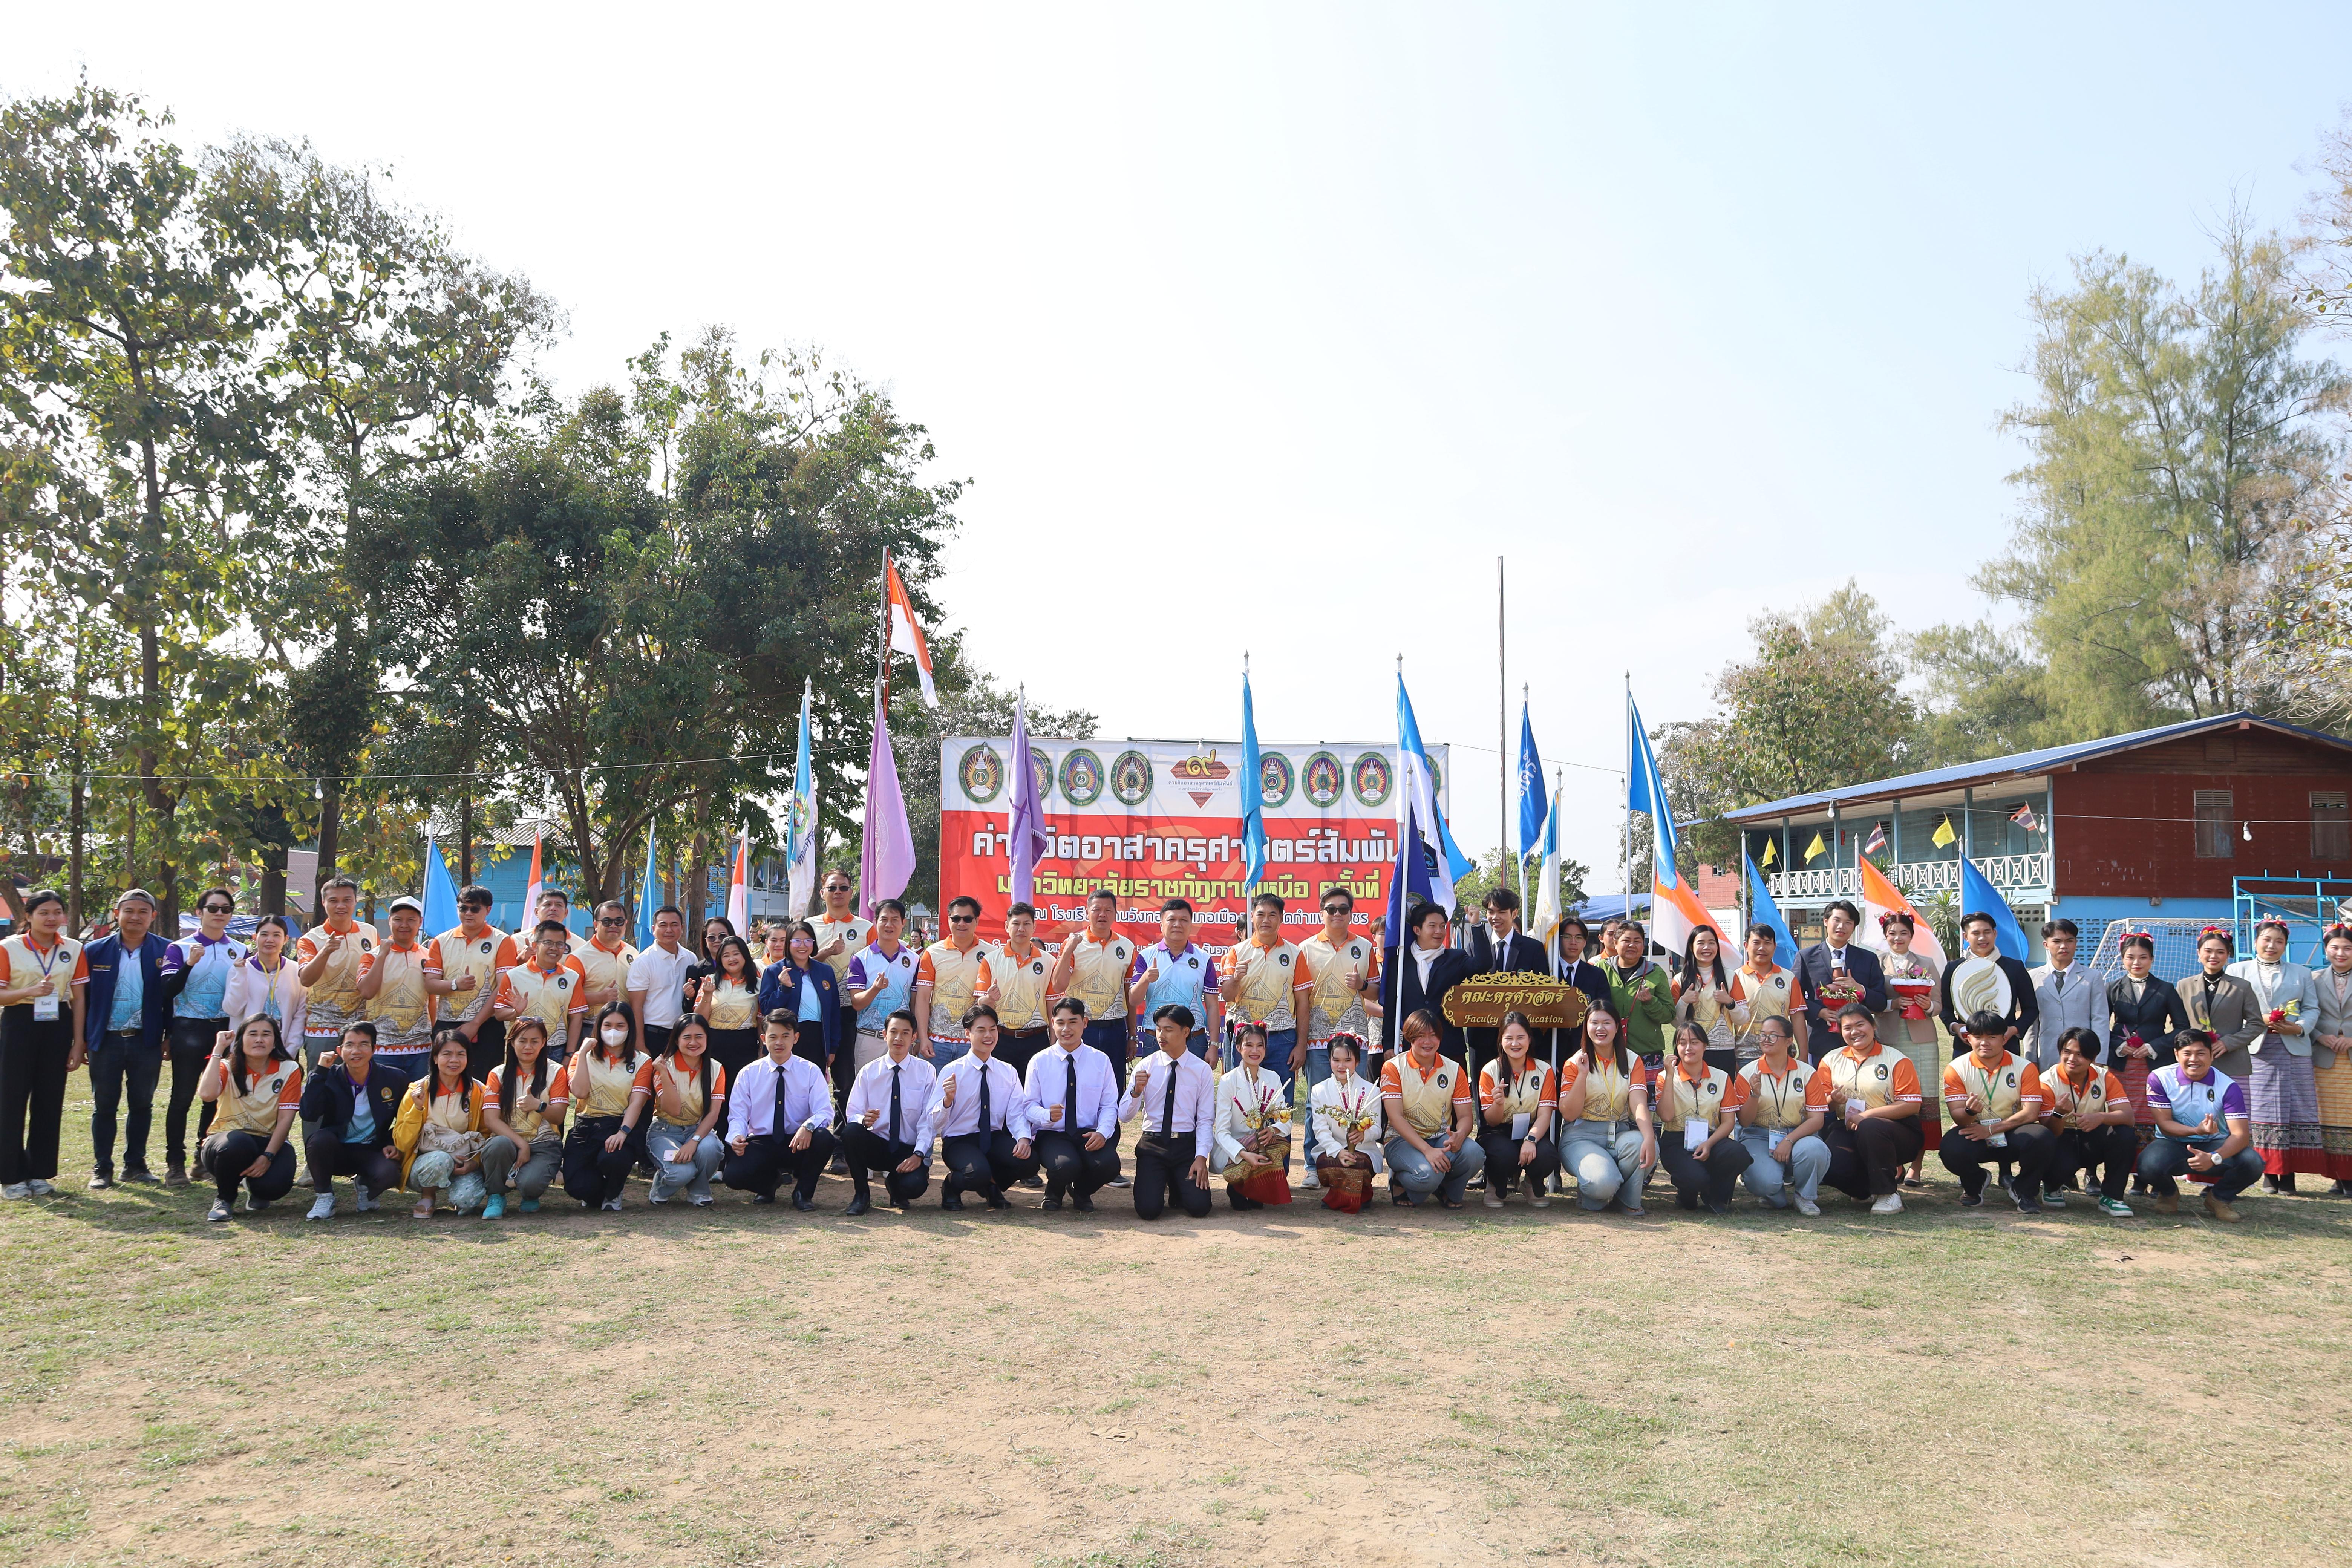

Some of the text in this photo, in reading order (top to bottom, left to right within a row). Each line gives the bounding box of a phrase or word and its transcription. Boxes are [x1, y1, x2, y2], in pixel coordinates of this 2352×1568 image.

[1461, 987, 1571, 1013] คณะครุศาสตร์
[1464, 1014, 1564, 1026] Faculty ucation
